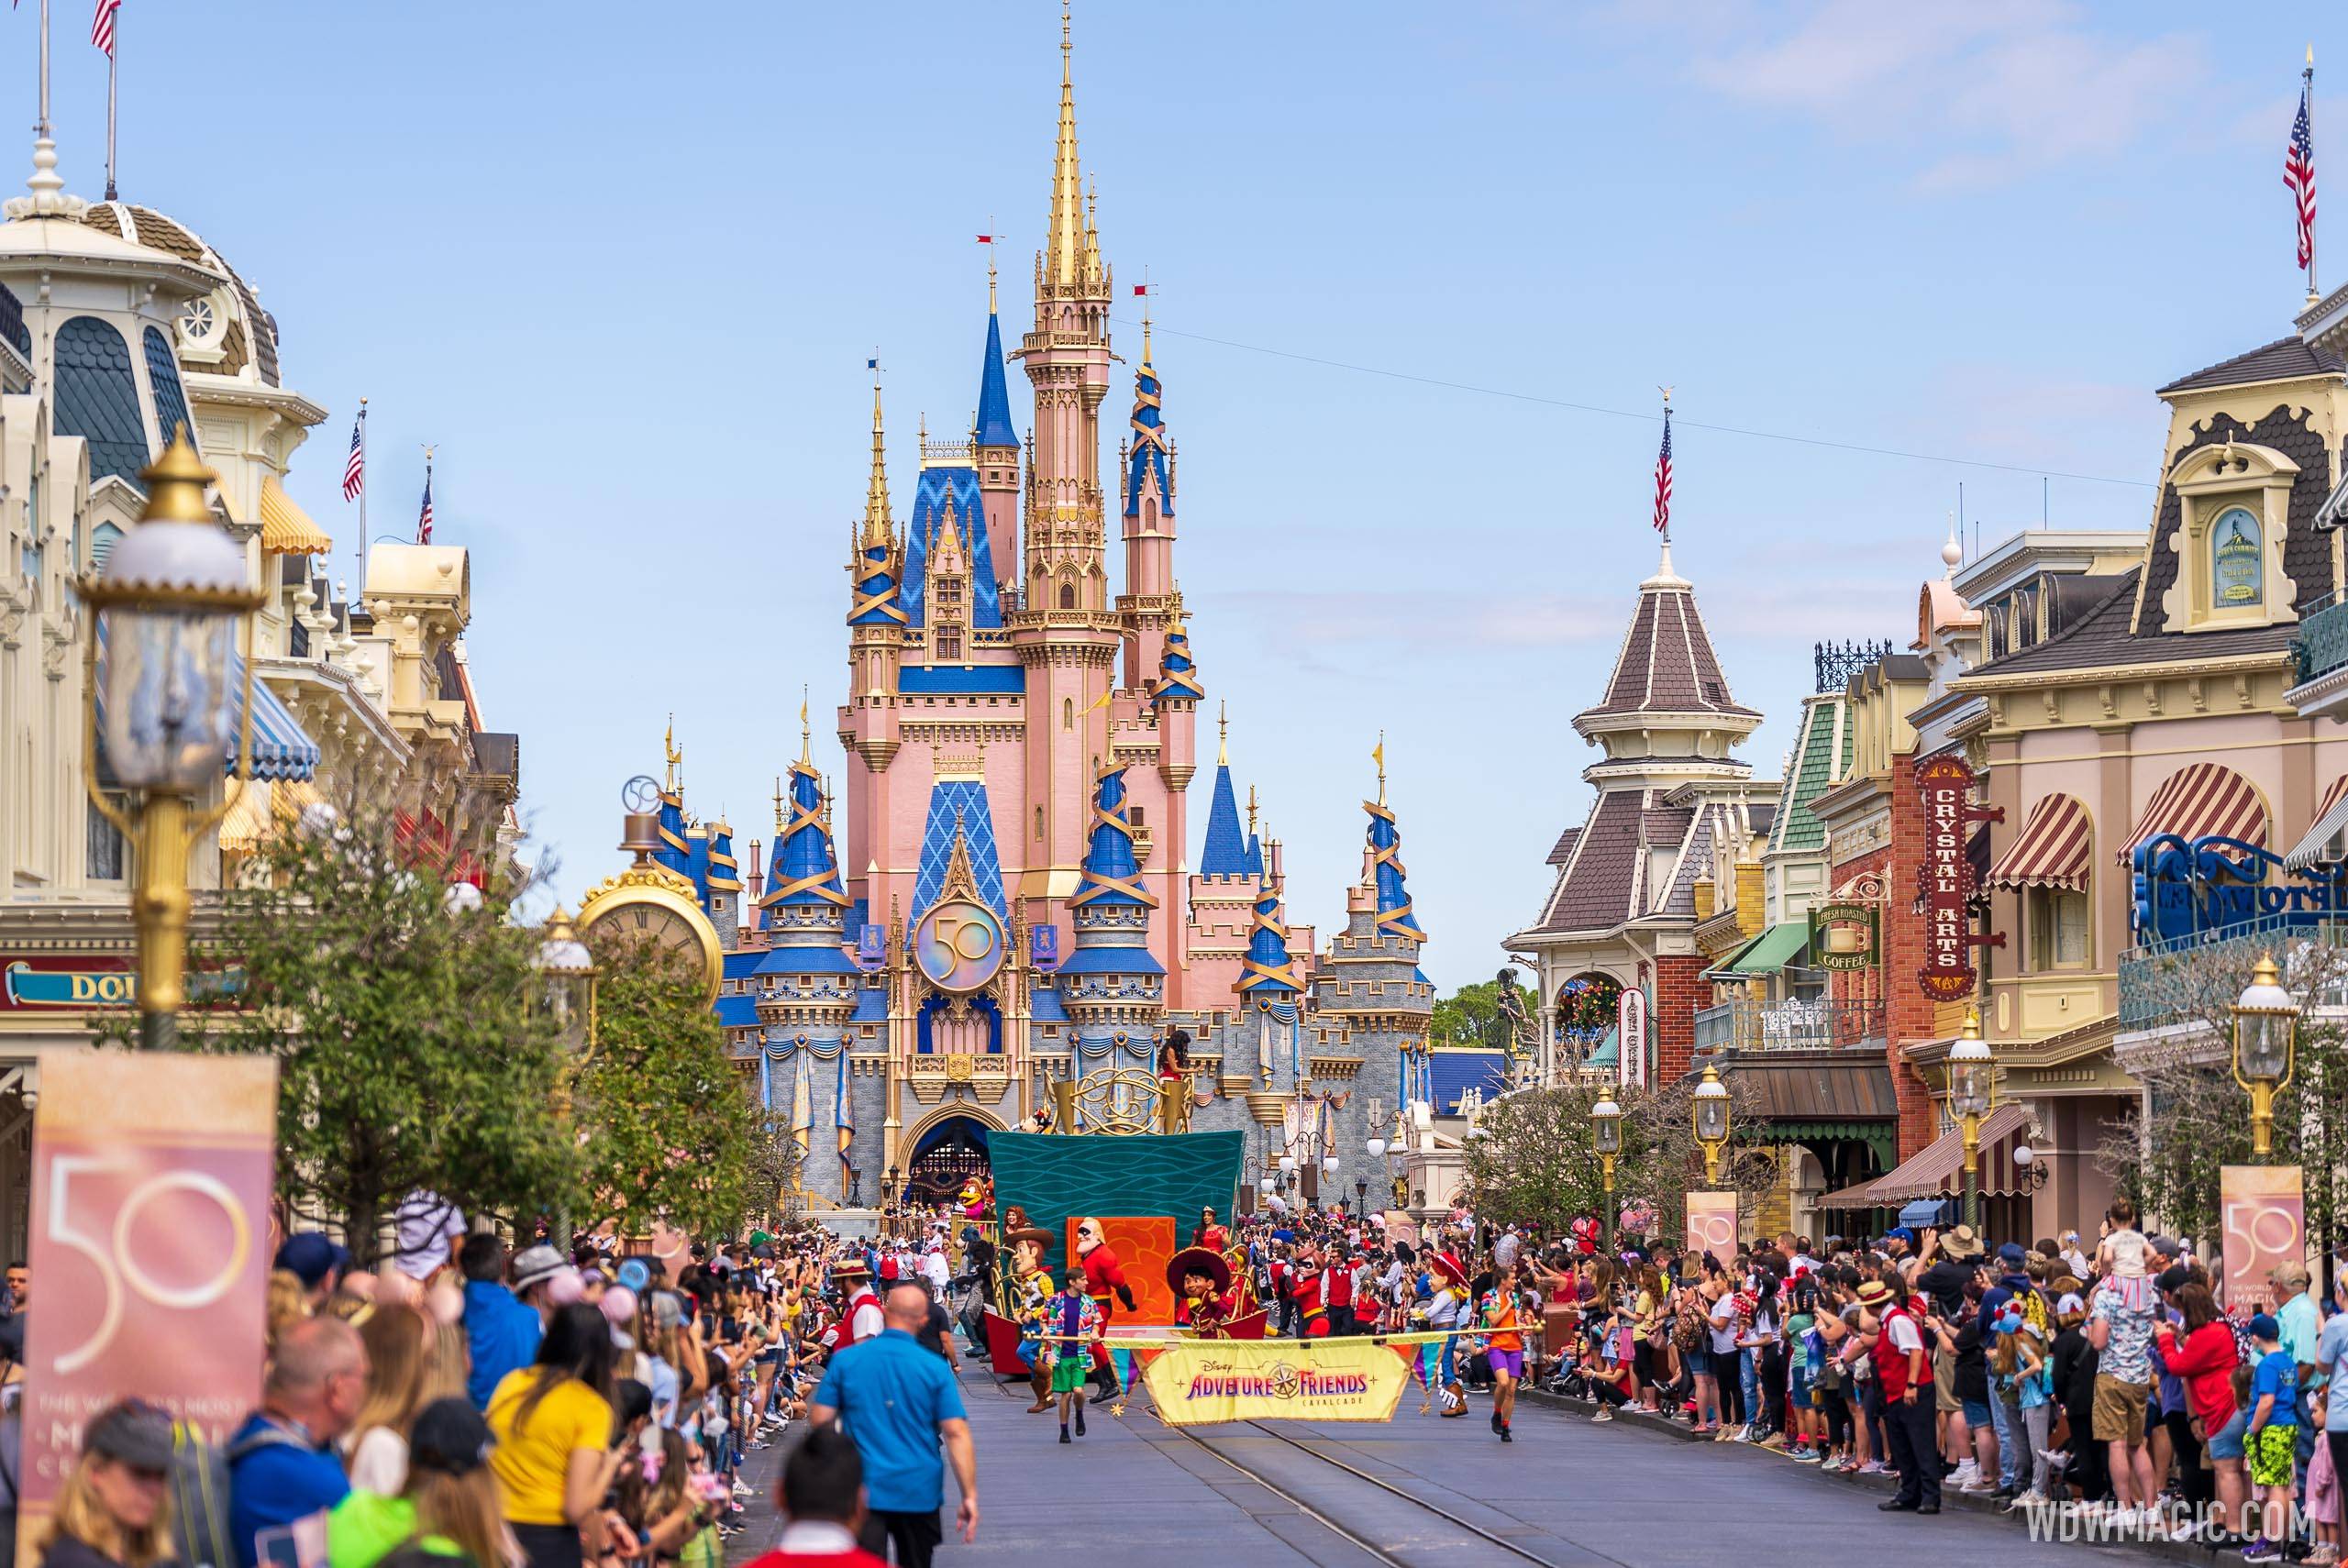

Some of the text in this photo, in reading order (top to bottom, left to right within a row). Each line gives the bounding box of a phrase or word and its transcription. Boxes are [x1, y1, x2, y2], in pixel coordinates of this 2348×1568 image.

[1935, 789, 1957, 892] CRYSTAL
[1821, 909, 1867, 922] FRESH ROASTED
[935, 916, 993, 981] 50
[1935, 909, 1958, 966] ARTS
[1822, 954, 1866, 968] COFFEE
[1626, 992, 1638, 1032] ICE
[1626, 1034, 1638, 1087] CREA
[1690, 1214, 1733, 1254] 50
[2227, 1203, 2297, 1279] 50
[48, 1155, 252, 1375] 50
[1199, 1359, 1234, 1374] Disney
[1293, 1369, 1368, 1397] FRIENDS
[1302, 1397, 1364, 1408] CAVALCADE
